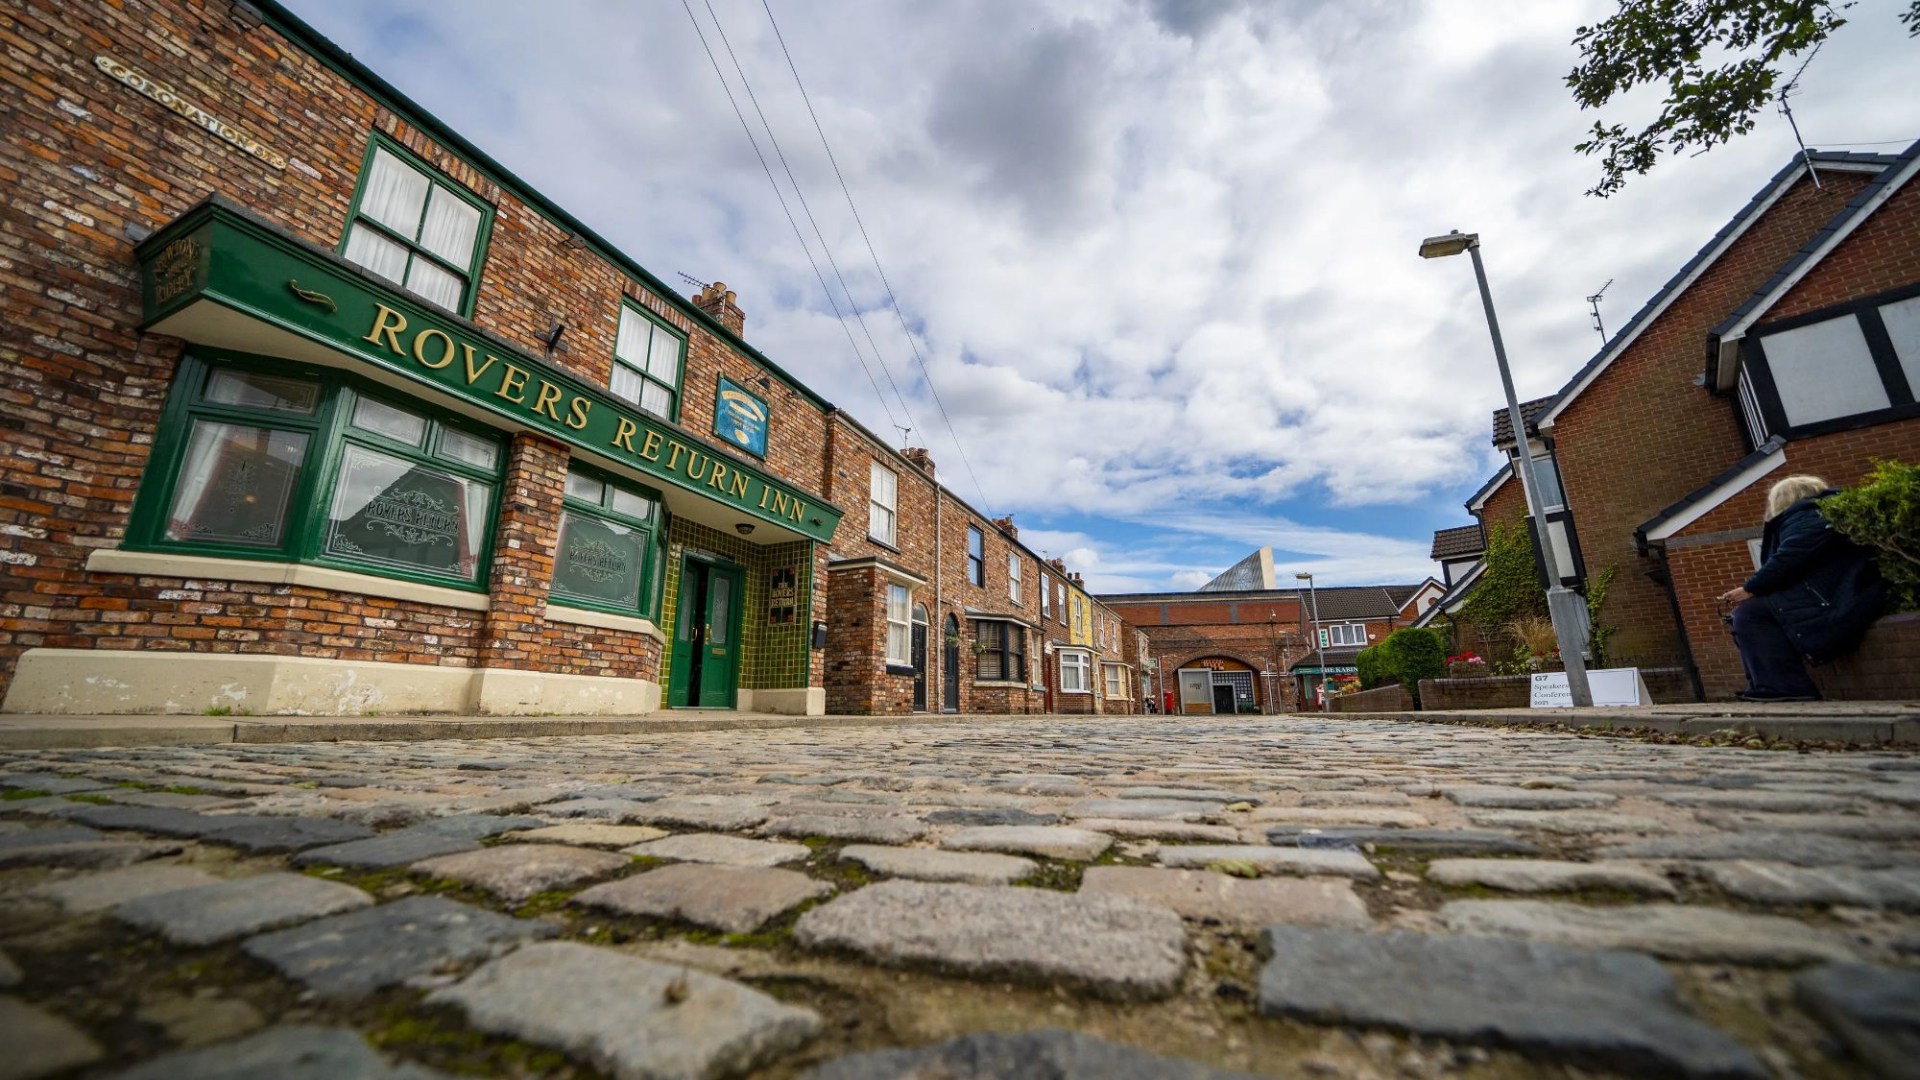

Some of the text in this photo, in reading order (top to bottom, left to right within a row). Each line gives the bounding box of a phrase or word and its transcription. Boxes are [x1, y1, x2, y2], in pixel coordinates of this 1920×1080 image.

[109, 64, 249, 149] CORONATION
[362, 302, 807, 523] ROVERS RETURN INN
[367, 500, 413, 522] ROVERS
